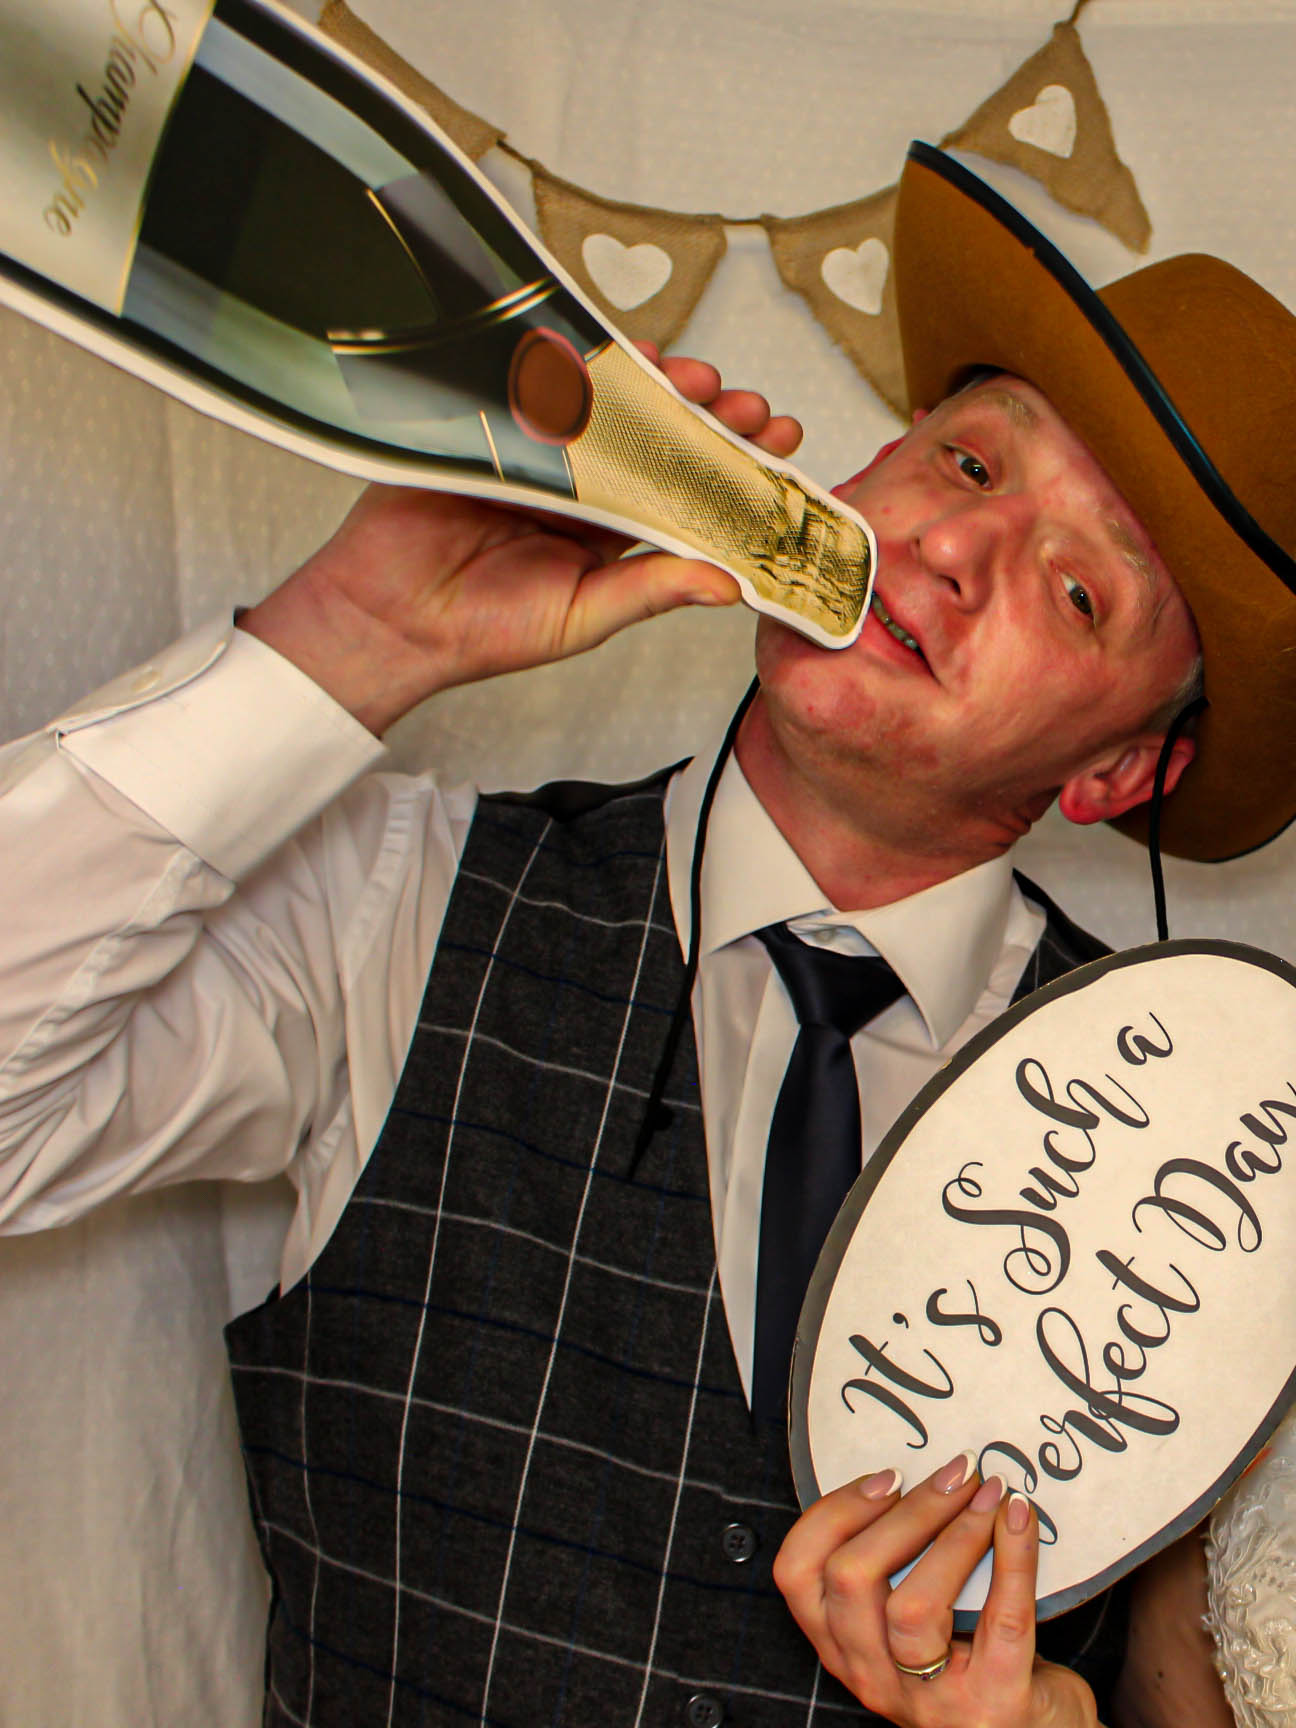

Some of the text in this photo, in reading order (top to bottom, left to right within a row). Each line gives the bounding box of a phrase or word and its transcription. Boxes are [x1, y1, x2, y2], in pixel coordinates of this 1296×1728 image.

[841, 1011, 1174, 1450] It's Such a
